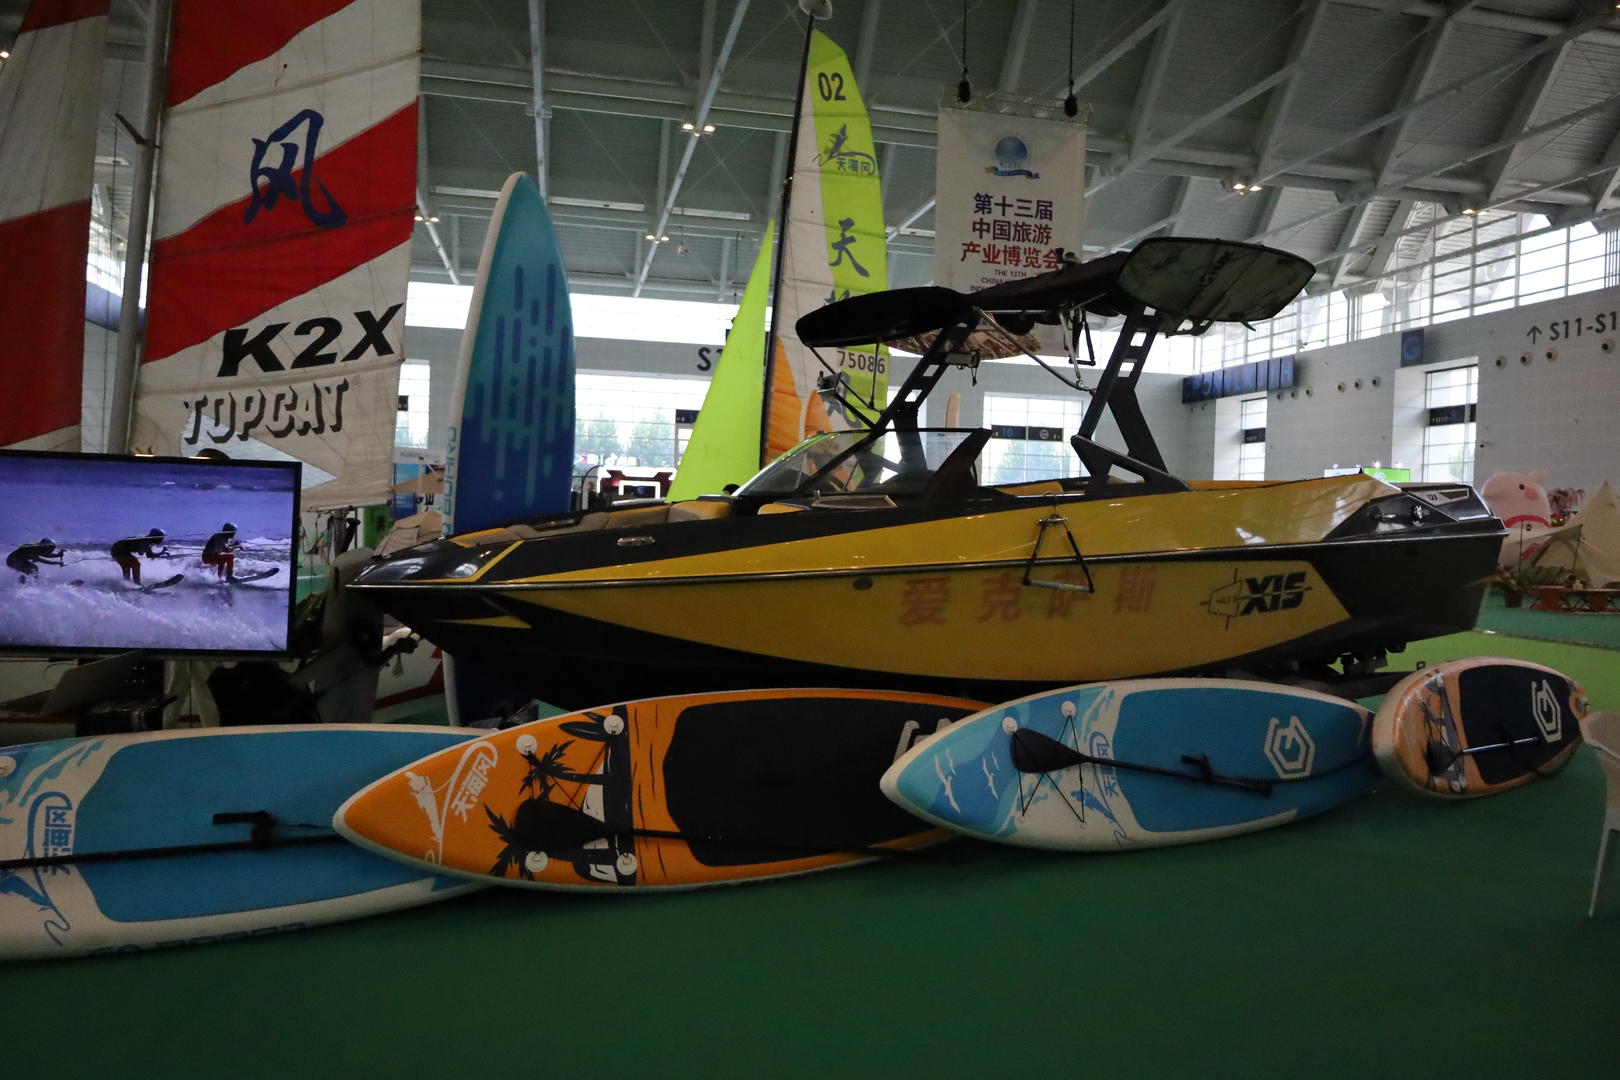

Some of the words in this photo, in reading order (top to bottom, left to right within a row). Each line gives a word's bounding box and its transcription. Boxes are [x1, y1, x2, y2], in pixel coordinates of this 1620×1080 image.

[818, 72, 846, 101] 02
[242, 109, 348, 229] 风
[973, 193, 1053, 221] 第十三届
[972, 218, 1052, 245] 中国旅游
[961, 242, 1059, 270] 产业博览会
[217, 302, 404, 377] K2X
[1550, 311, 1617, 341] S11-S1
[837, 350, 886, 375] 75086
[183, 378, 350, 445] TOPCAT
